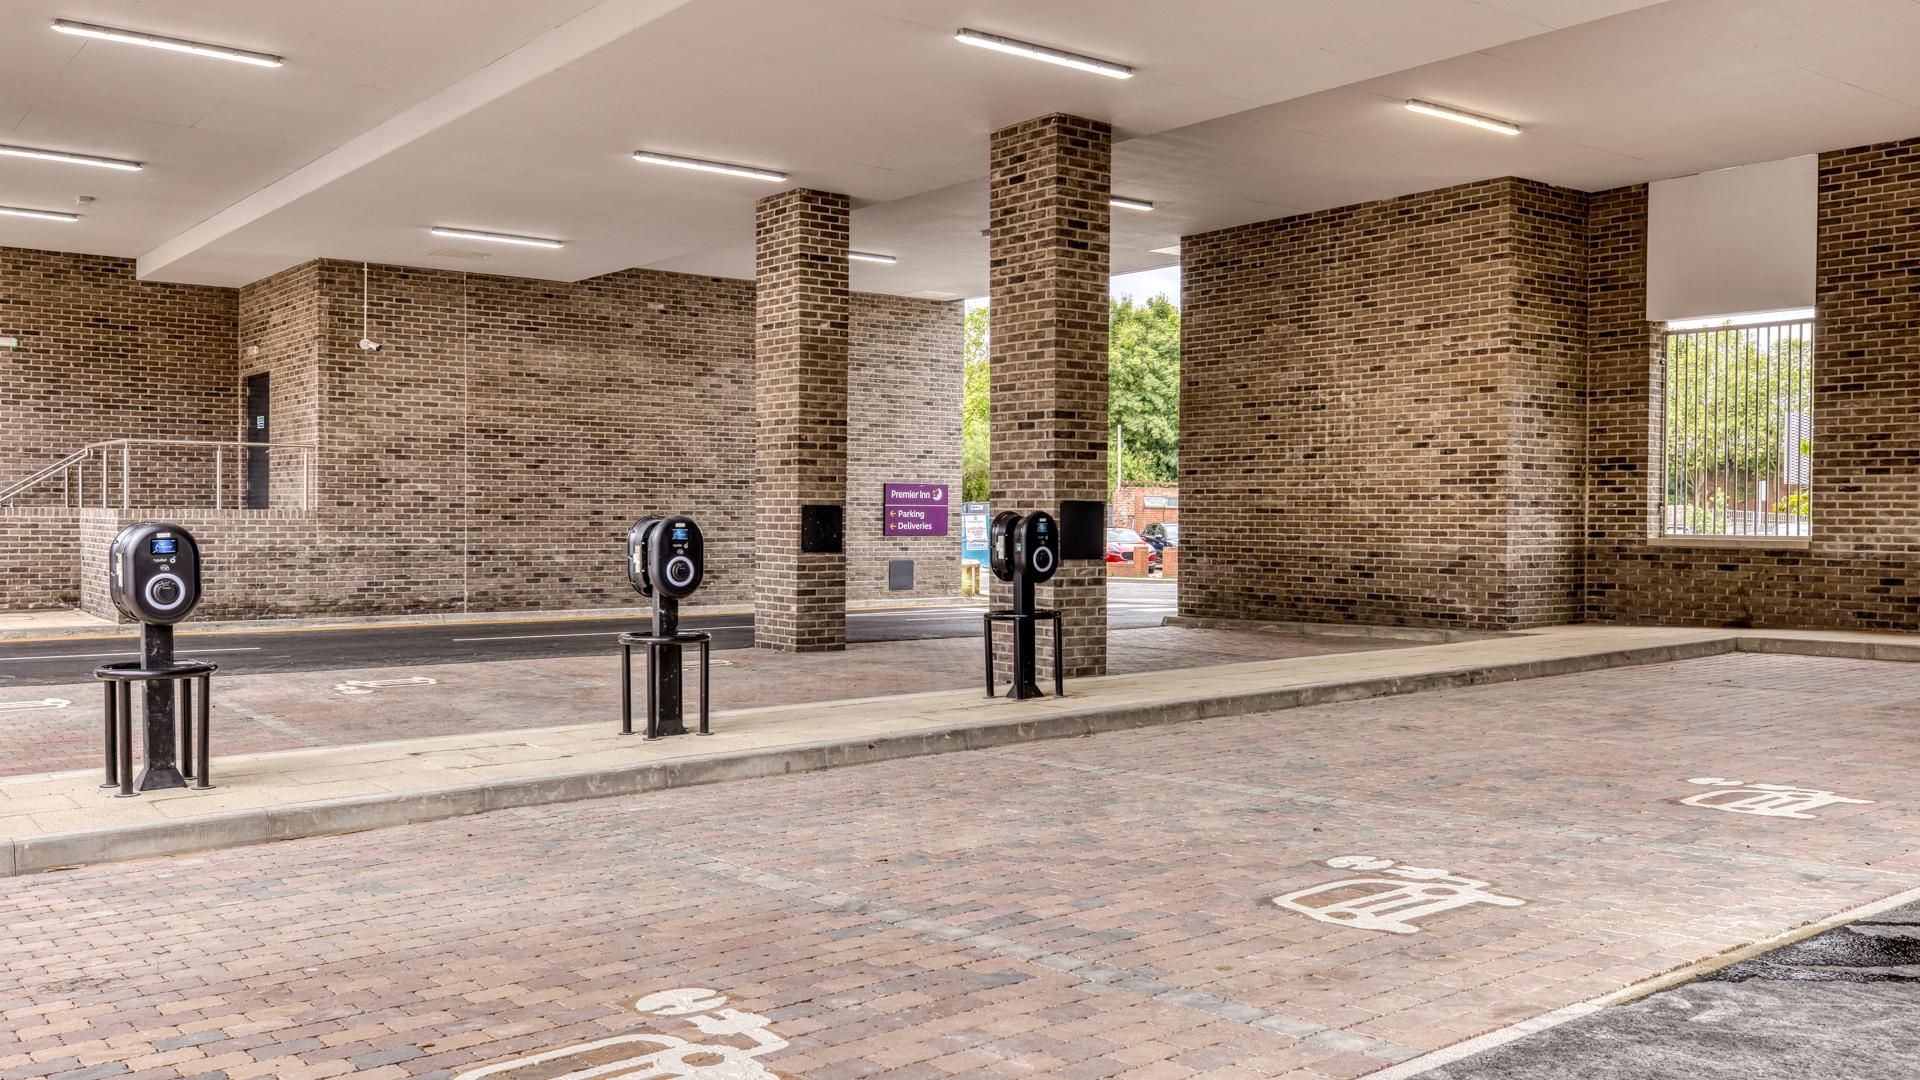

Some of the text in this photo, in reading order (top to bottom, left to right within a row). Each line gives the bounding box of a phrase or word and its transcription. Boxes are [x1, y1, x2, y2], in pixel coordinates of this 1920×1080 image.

[891, 490, 930, 499] Premier Inn
[898, 510, 924, 520] Parking
[898, 522, 932, 530] Deliveries
